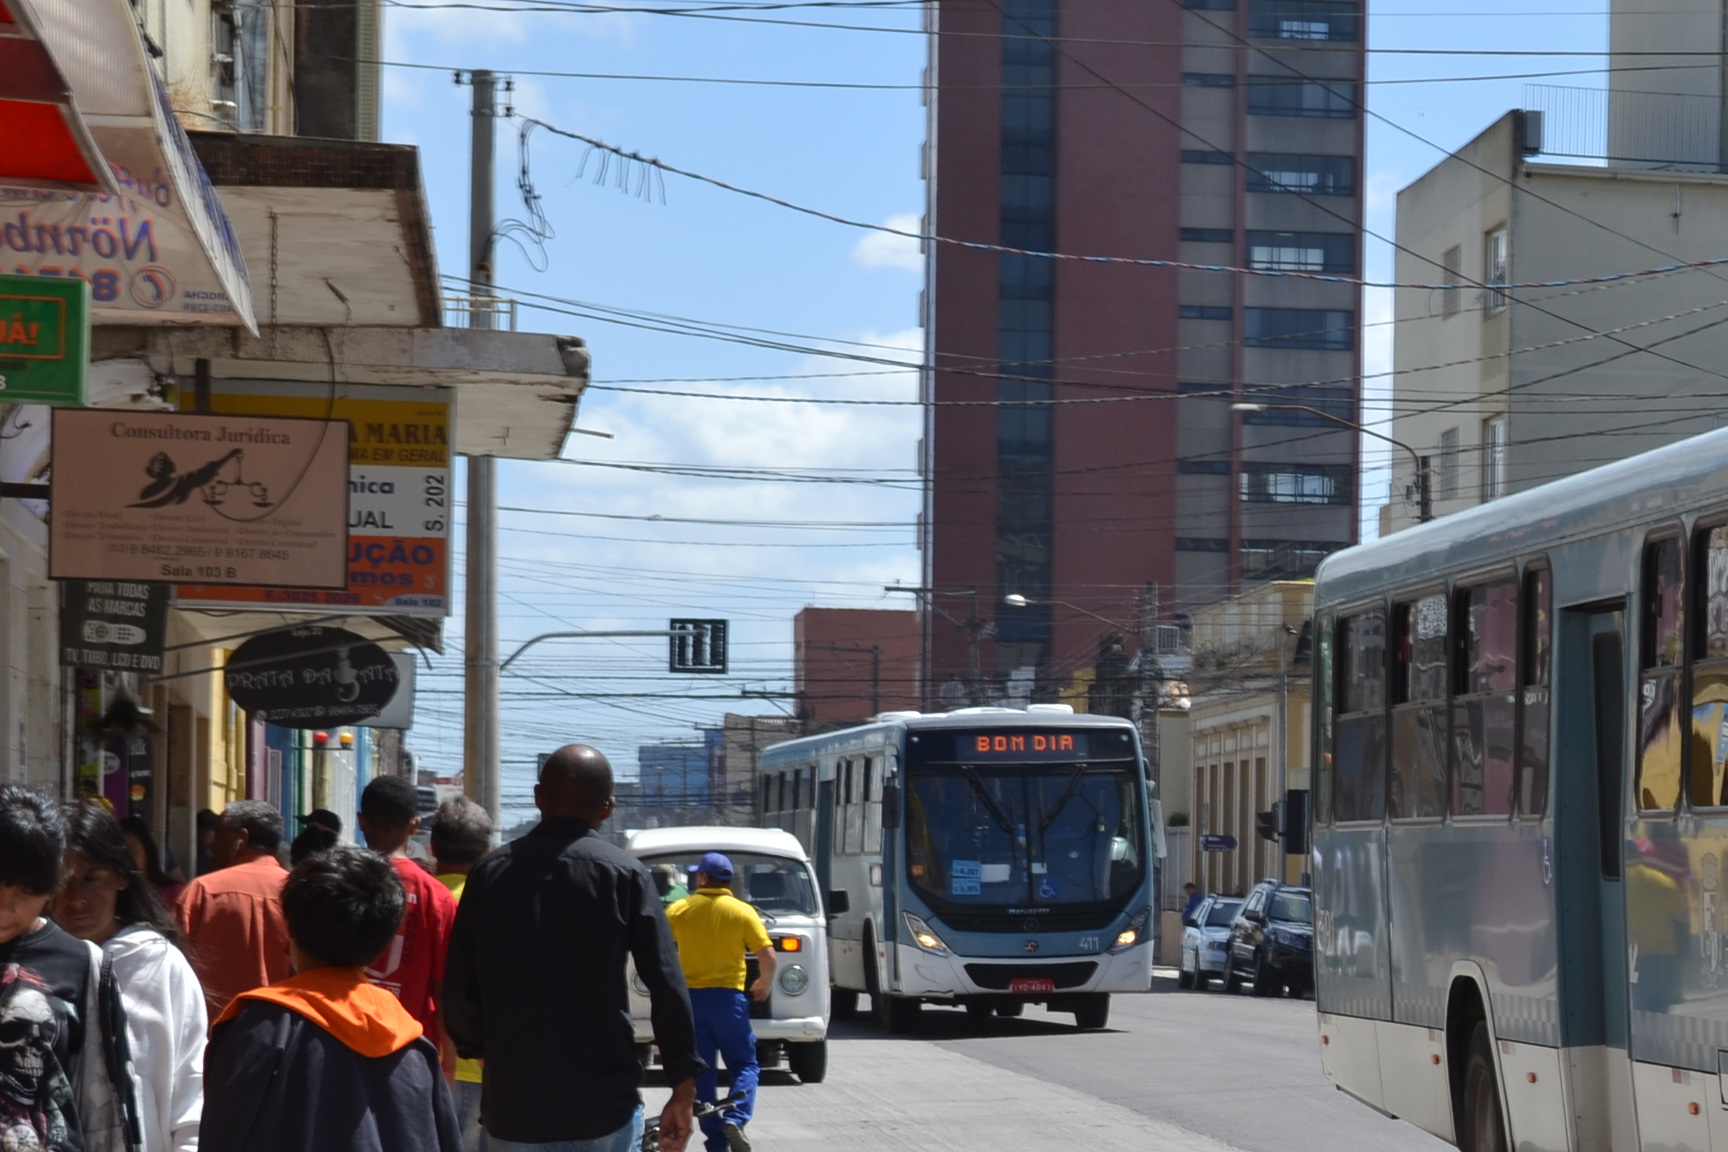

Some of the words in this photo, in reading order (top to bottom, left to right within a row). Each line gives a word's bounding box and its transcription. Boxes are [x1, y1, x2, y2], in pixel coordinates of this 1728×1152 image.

[111, 421, 213, 441] Consultora
[217, 425, 291, 446] Jurídica
[366, 422, 448, 444] MARIA
[399, 448, 446, 462] GERAL
[425, 474, 445, 508] 202
[162, 563, 194, 577] Sala
[117, 582, 150, 600] TODAS
[89, 598, 103, 614] AS
[104, 599, 147, 618] MARCAS
[113, 652, 132, 667] LCD
[140, 655, 161, 670] DVD
[302, 667, 333, 686] DA
[976, 734, 1025, 752] BOM
[1032, 734, 1073, 751] DIA
[1079, 936, 1099, 950] 411
